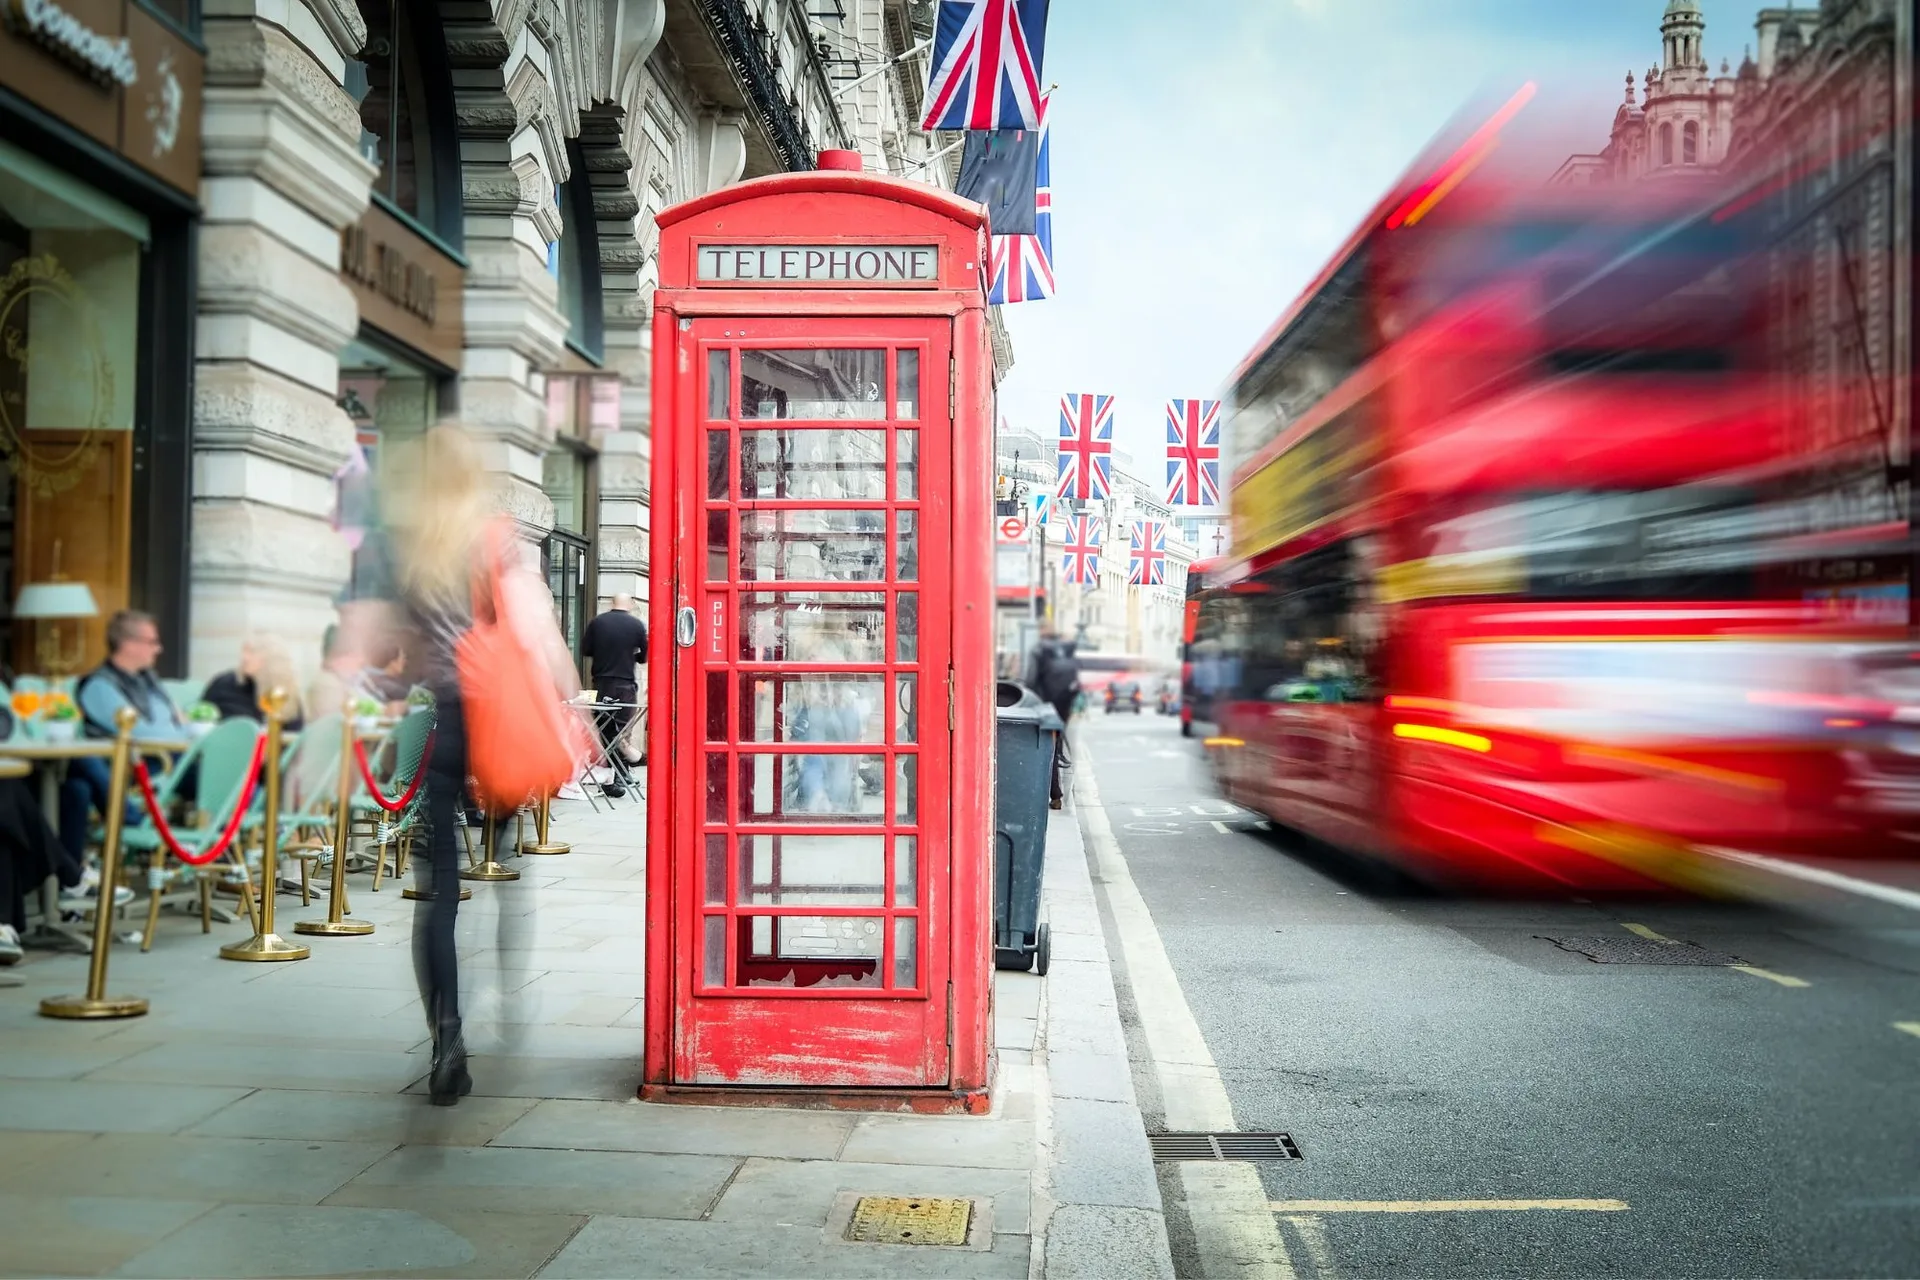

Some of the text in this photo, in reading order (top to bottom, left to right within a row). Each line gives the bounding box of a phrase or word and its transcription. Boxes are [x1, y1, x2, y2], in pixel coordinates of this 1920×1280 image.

[706, 250, 929, 280] TELEPHONE
[713, 601, 723, 653] PULL
[1131, 805, 1239, 818] BU
